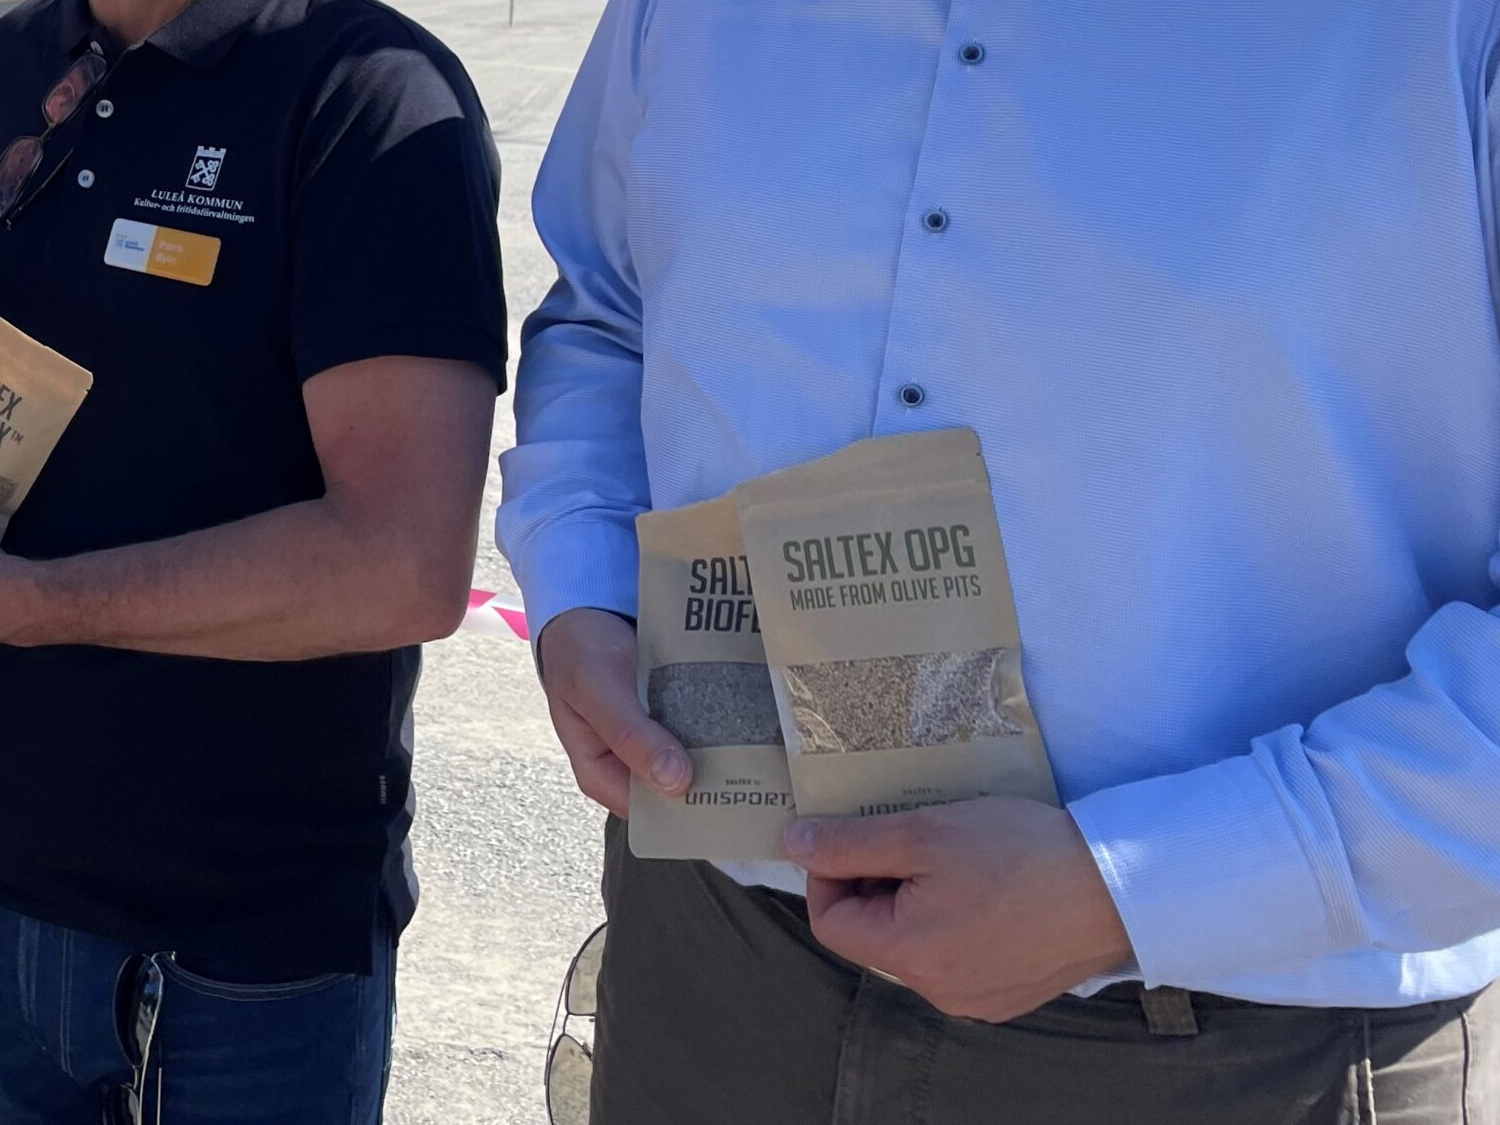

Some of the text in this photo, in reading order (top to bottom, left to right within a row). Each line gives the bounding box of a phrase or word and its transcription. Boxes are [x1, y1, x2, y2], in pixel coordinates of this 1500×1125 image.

[151, 189, 244, 210] LULEÅ KOMMUN
[161, 203, 175, 212] och
[783, 525, 976, 583] SALTEX OPG
[689, 555, 753, 595] SALT
[790, 574, 982, 611] MADE FROM OLIVE PITS
[685, 597, 761, 634] BIOFL
